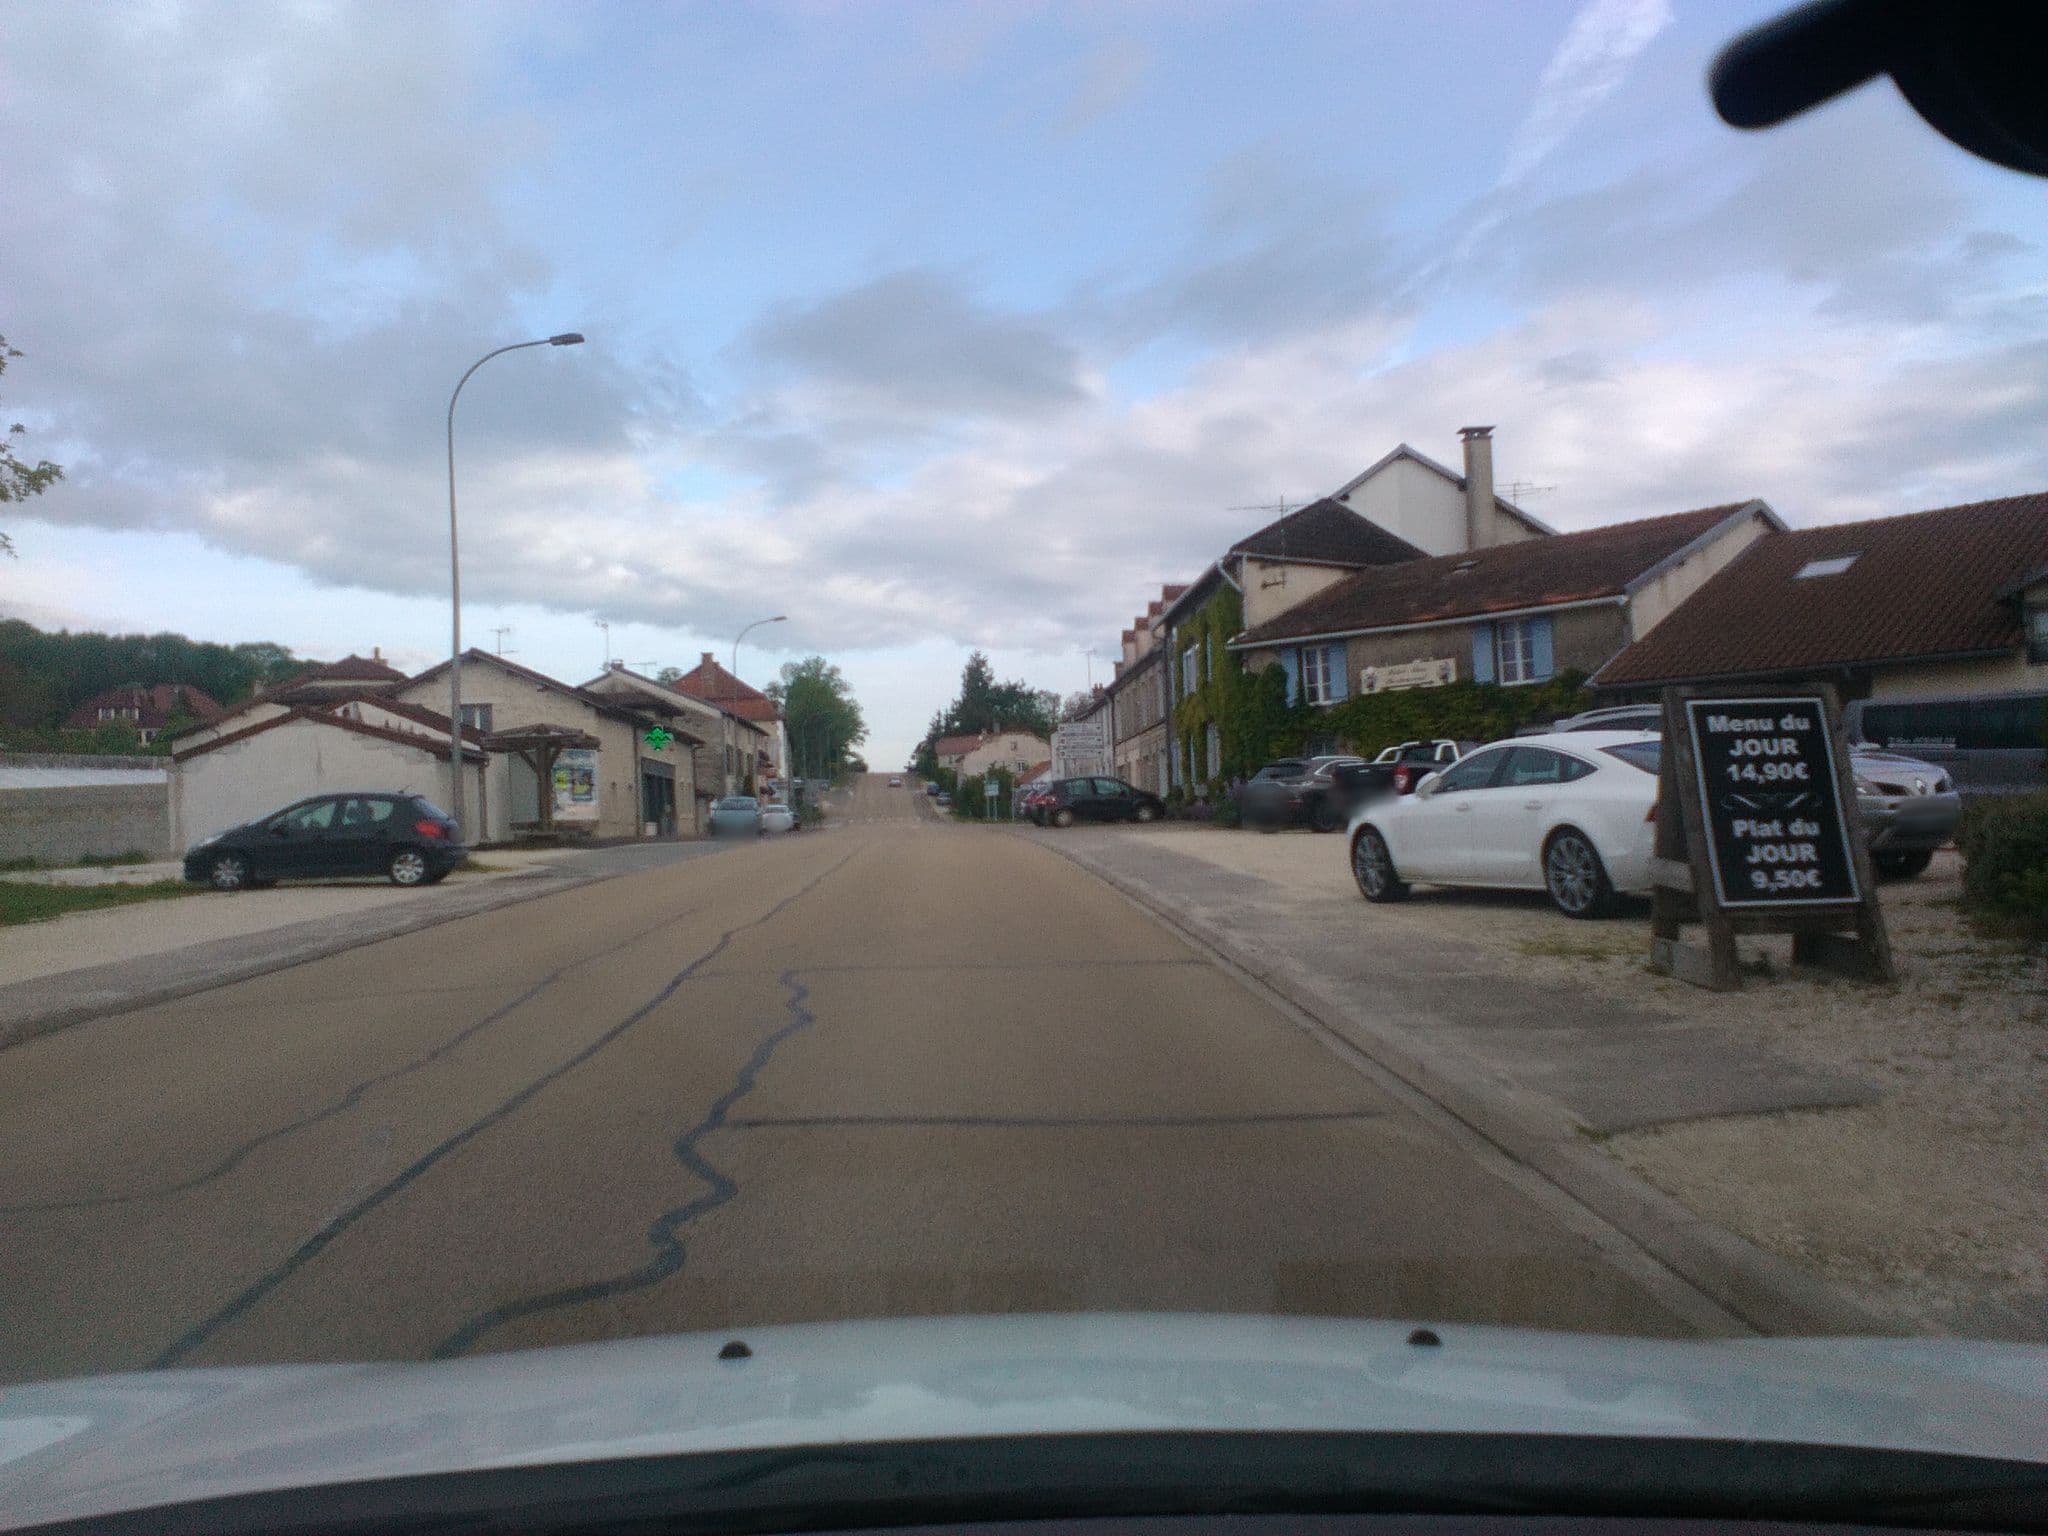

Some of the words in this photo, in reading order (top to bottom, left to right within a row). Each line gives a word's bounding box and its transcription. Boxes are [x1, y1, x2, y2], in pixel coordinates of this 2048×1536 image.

[1706, 715, 1774, 732] Menu
[1780, 713, 1810, 730] du
[1729, 738, 1799, 756] JOUR
[1727, 762, 1810, 784] 14,90€
[1732, 819, 1782, 837] Plat
[1788, 818, 1820, 835] du
[1746, 843, 1817, 863] JOUR
[1750, 869, 1823, 891] 9,50€
